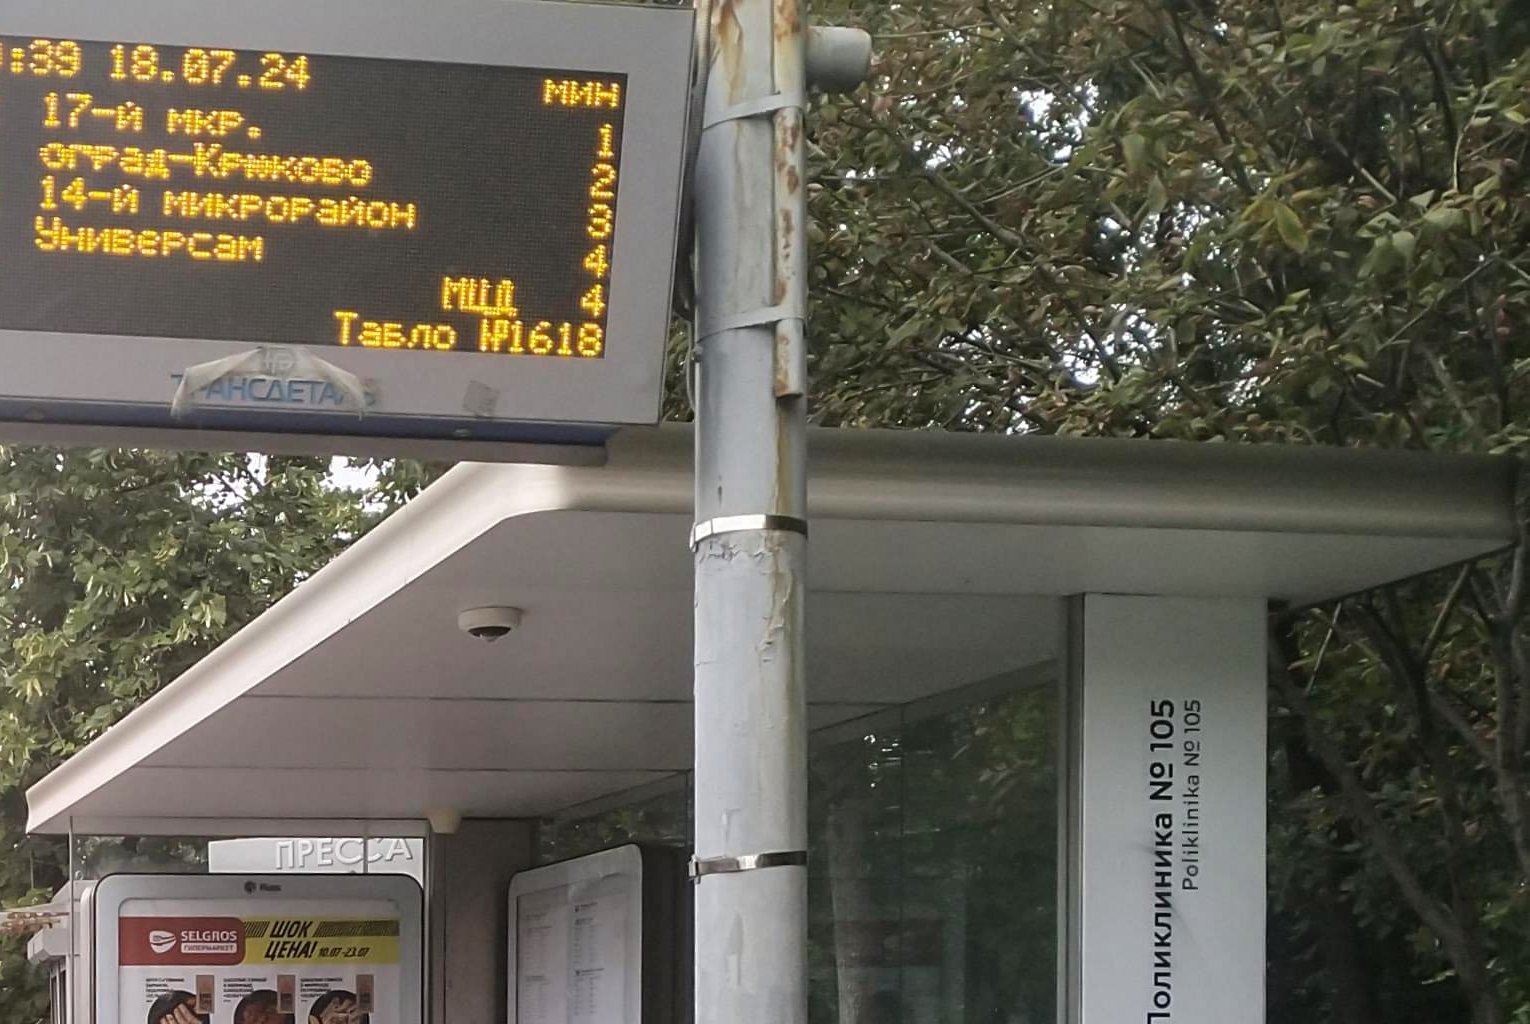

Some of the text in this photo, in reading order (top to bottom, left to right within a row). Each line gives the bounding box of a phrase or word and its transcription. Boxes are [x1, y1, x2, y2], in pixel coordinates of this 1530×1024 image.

[110, 44, 311, 90] 18.07.24
[43, 92, 144, 133] 17-й
[166, 108, 262, 140] мкр.
[597, 123, 614, 159] 1
[589, 163, 616, 199] 2
[39, 175, 140, 214] 14-й
[162, 190, 416, 229] микрорайон
[587, 203, 613, 239] 3
[34, 215, 264, 262] Универсам
[583, 244, 609, 279] 4
[441, 276, 518, 319] МЦД
[580, 284, 606, 318] 4
[334, 311, 603, 358] Табло №1618
[1150, 699, 1175, 752] 105
[1149, 761, 1174, 801] №
[1181, 699, 1201, 890] Poliklinika № 105
[181, 930, 238, 941] SELGROS
[264, 941, 319, 961] ЦЕНА!
[269, 920, 313, 938] ШОК
